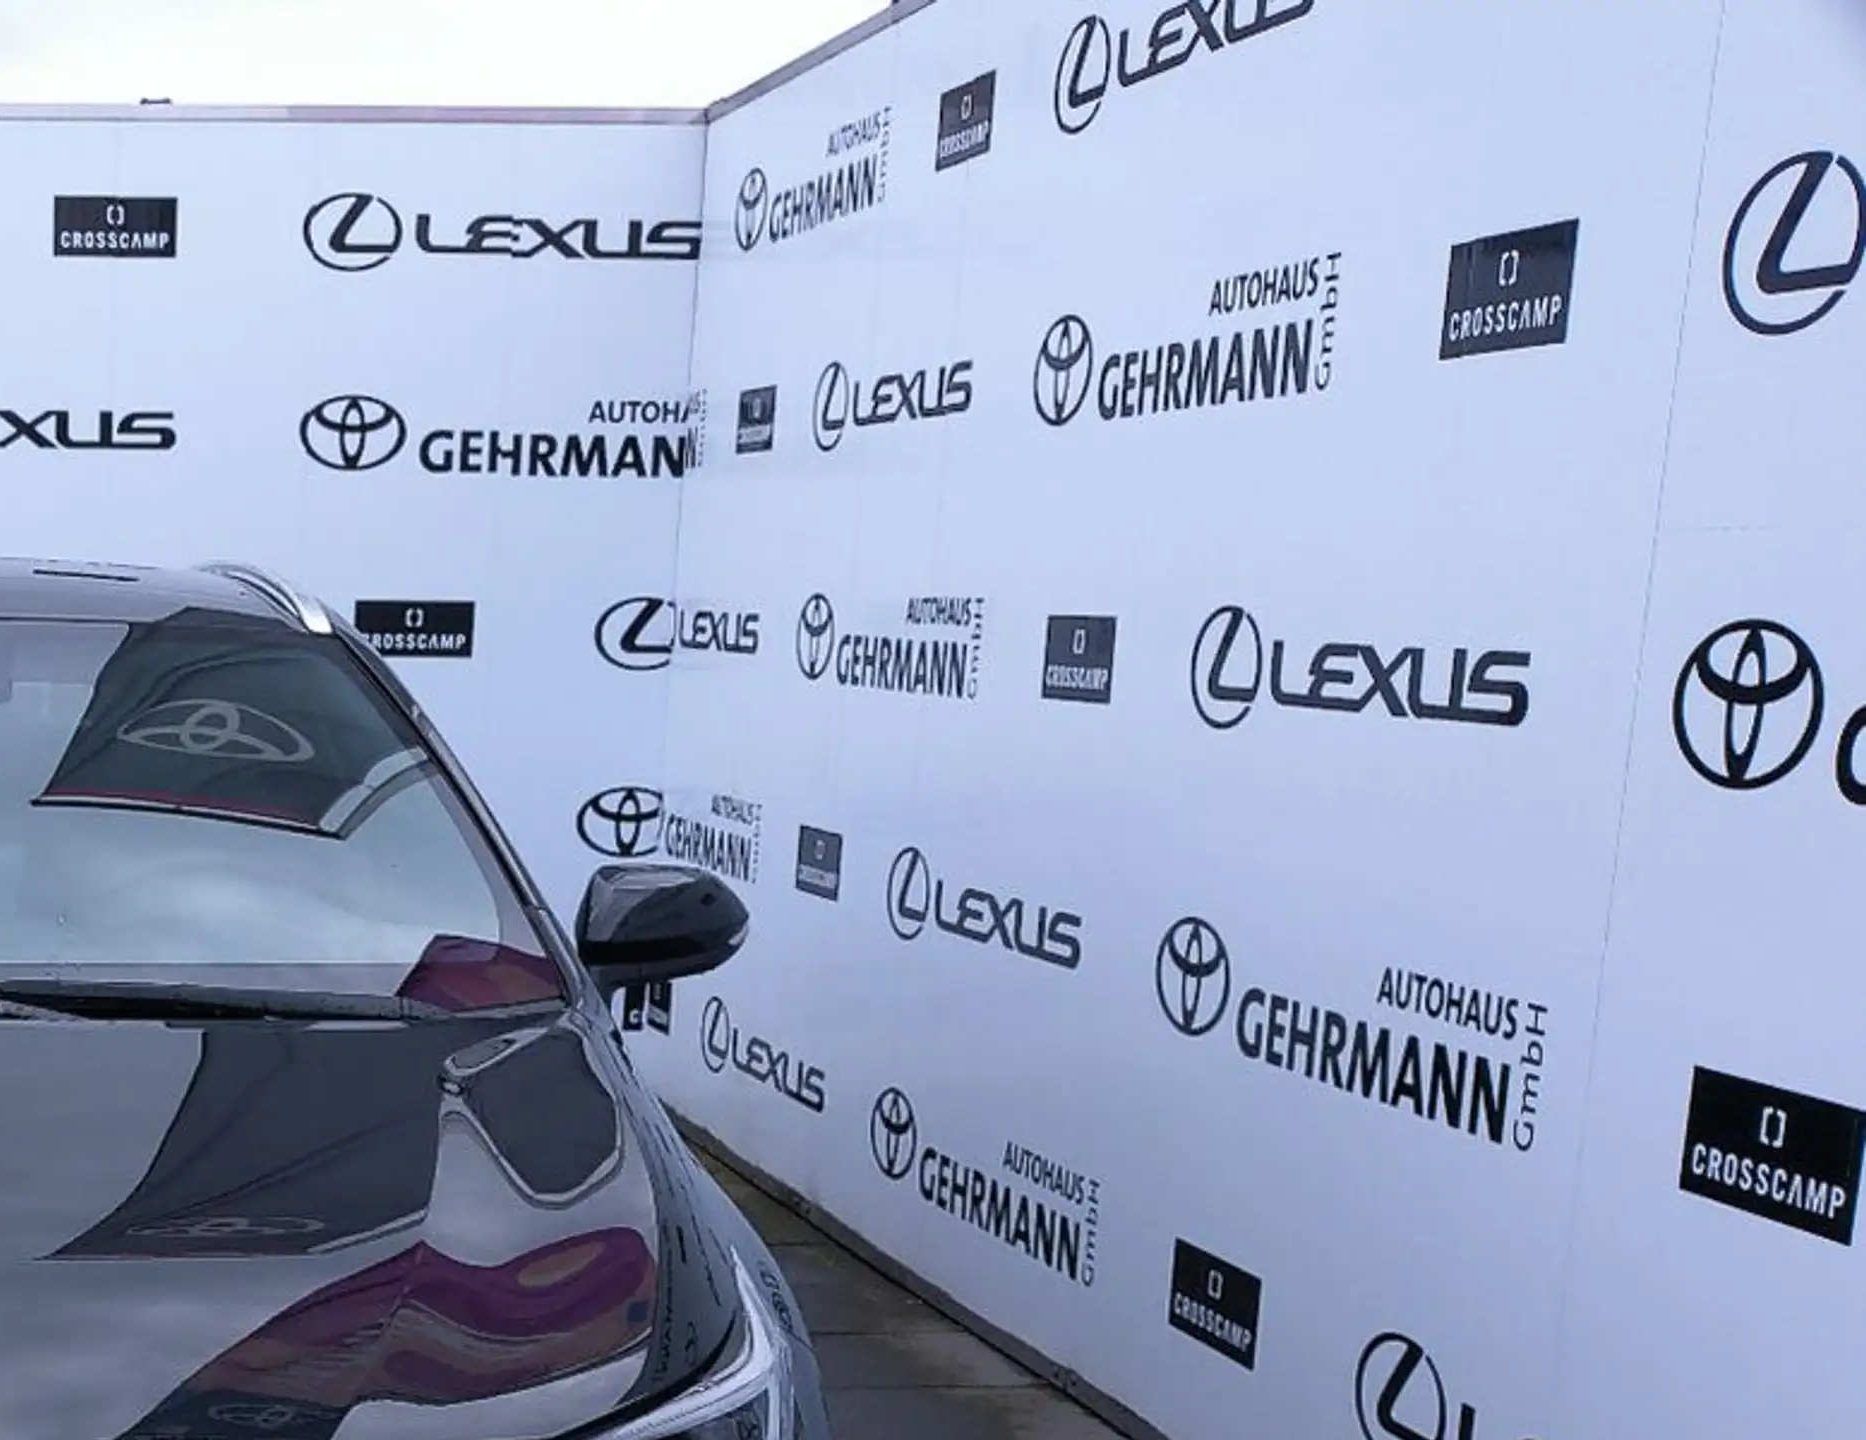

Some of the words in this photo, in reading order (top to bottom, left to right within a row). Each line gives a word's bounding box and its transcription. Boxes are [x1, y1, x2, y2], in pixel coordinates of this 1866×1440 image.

[769, 155, 879, 243] GEHRMANN
[61, 231, 169, 248] CROSSCAMP
[416, 214, 703, 260] LEXUS
[1210, 258, 1318, 317] AUTOHAUS
[1315, 251, 1342, 391] GmbH
[1449, 296, 1561, 341] CROSSCAMP
[854, 360, 973, 427] LEXUS
[1098, 321, 1314, 420] GEHRMANN
[677, 610, 760, 655] LEXUS
[906, 597, 973, 628] AUTOHAUS
[836, 633, 968, 699] GEHRMANN
[1271, 639, 1531, 726] LEXUS
[934, 879, 1082, 969] LEXUS
[1378, 967, 1519, 1039] AUTOHAUS
[730, 1029, 826, 1114] LEXUS
[1236, 987, 1511, 1145] GEHRMANN
[1513, 1003, 1548, 1152] GmbH
[1002, 1141, 1085, 1206] AUTOHAUS
[1691, 1143, 1846, 1220] CROSSCAMP
[919, 1147, 1081, 1283] GEHRMANN
[1172, 1291, 1252, 1353] CROSSCAMP
